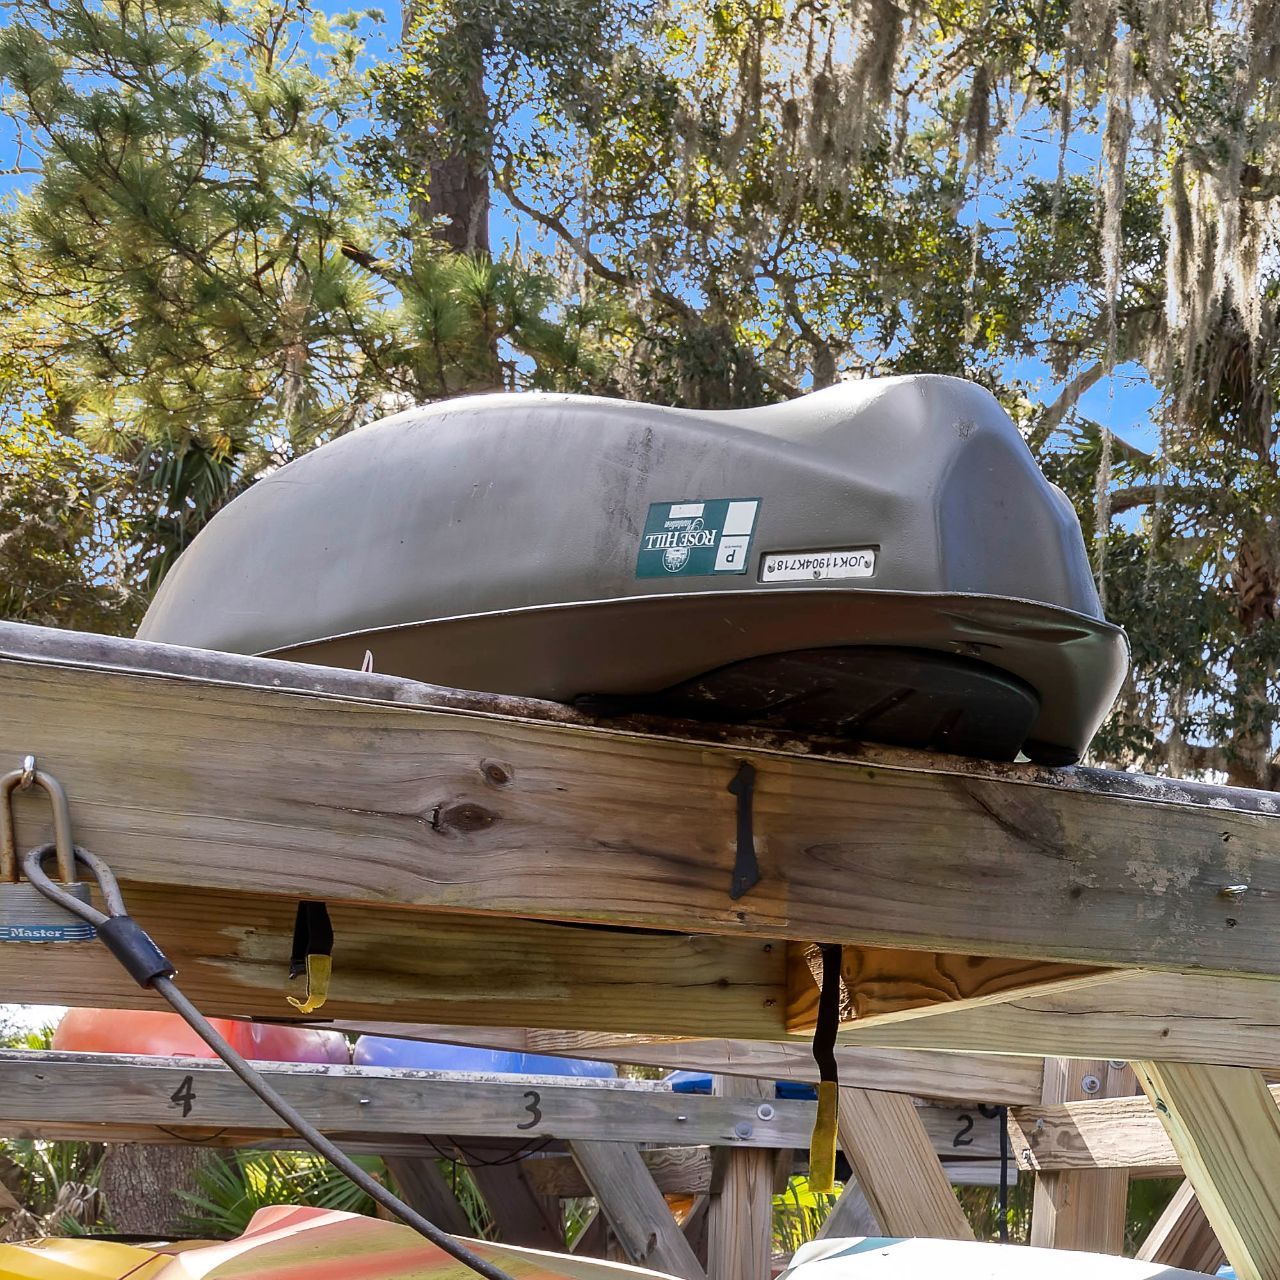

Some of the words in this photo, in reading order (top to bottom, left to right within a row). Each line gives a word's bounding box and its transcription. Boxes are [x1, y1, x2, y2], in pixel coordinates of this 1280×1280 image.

[645, 533, 680, 549] HILL
[680, 529, 718, 546] ROSE
[725, 549, 736, 563] P
[726, 761, 760, 900] 1
[10, 927, 62, 938] Master
[170, 1075, 196, 1118] 4
[516, 1090, 542, 1130] 3
[952, 1114, 974, 1147] 2
